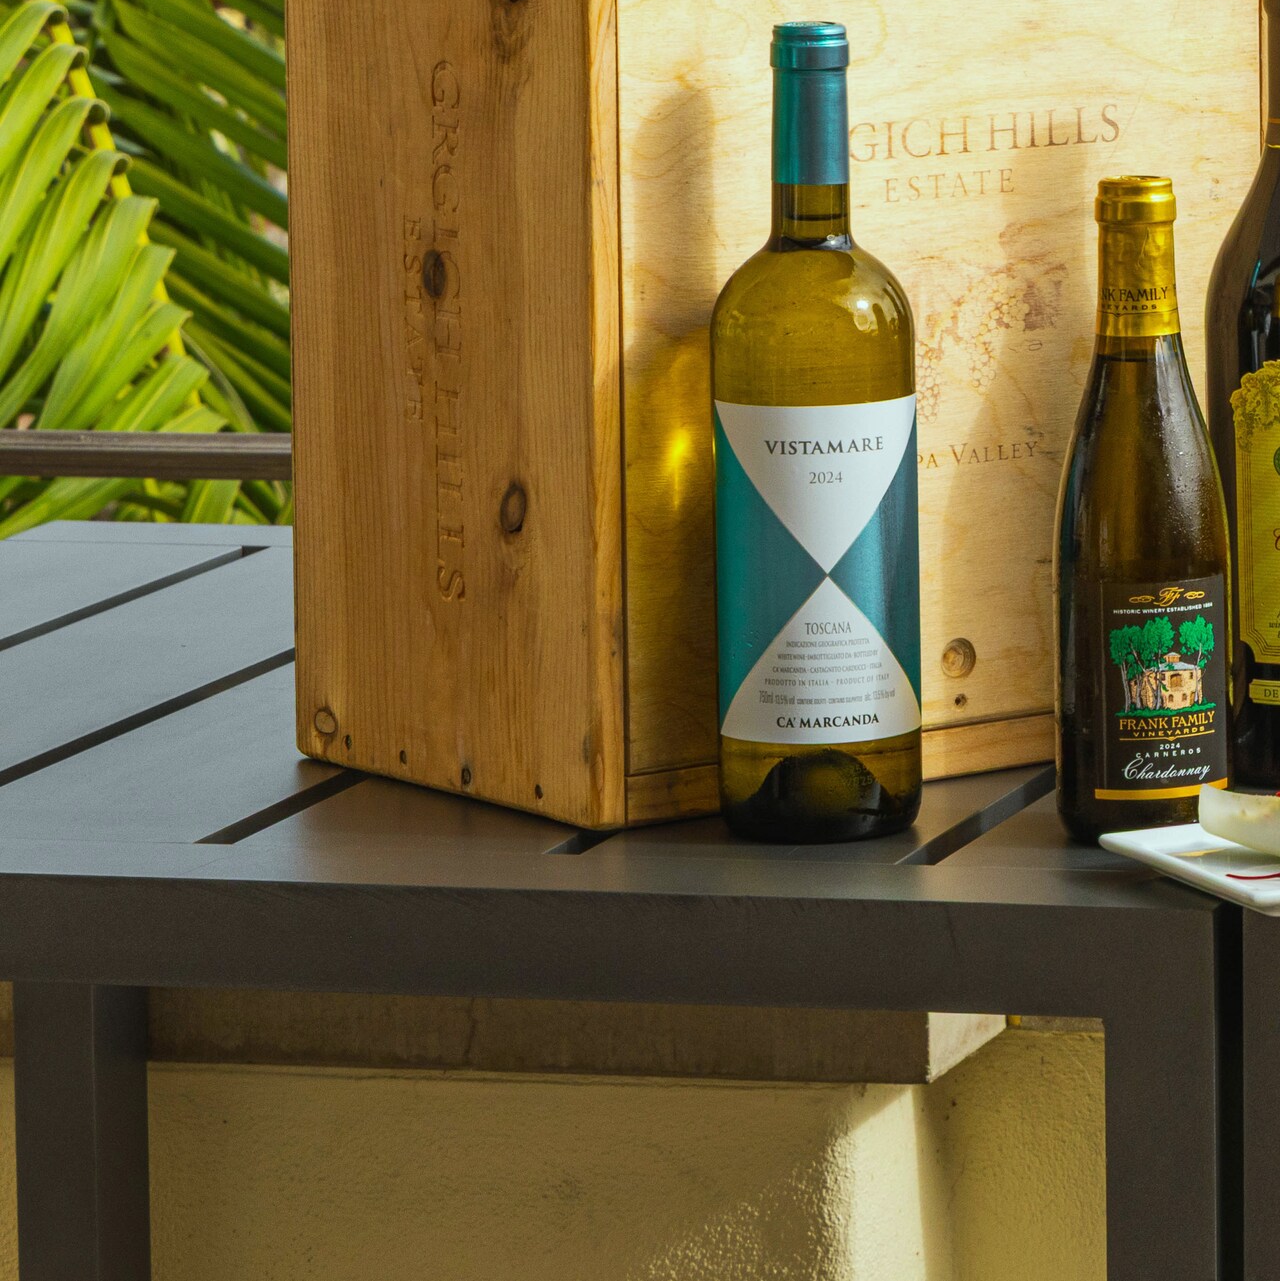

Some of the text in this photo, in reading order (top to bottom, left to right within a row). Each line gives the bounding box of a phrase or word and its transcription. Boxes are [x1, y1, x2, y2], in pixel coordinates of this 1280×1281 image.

[849, 103, 1121, 164] GICH HILLS
[885, 168, 1015, 204] ESTATE
[1119, 286, 1168, 301] FAMILY
[764, 435, 885, 456] VISTAMARE
[809, 471, 844, 485] 2024
[1166, 603, 1202, 613] ESTABLISHED
[805, 621, 852, 635] TOSCANA
[808, 679, 829, 687] ITALIA
[776, 714, 880, 728] CA' MARCANDA
[1119, 710, 1215, 730] FRANK FAMILY
[1133, 725, 1205, 737] VINEYARDS
[1135, 747, 1201, 758] CARNEROS
[1159, 742, 1180, 750] 2024
[1121, 757, 1211, 780] Chardonnay
